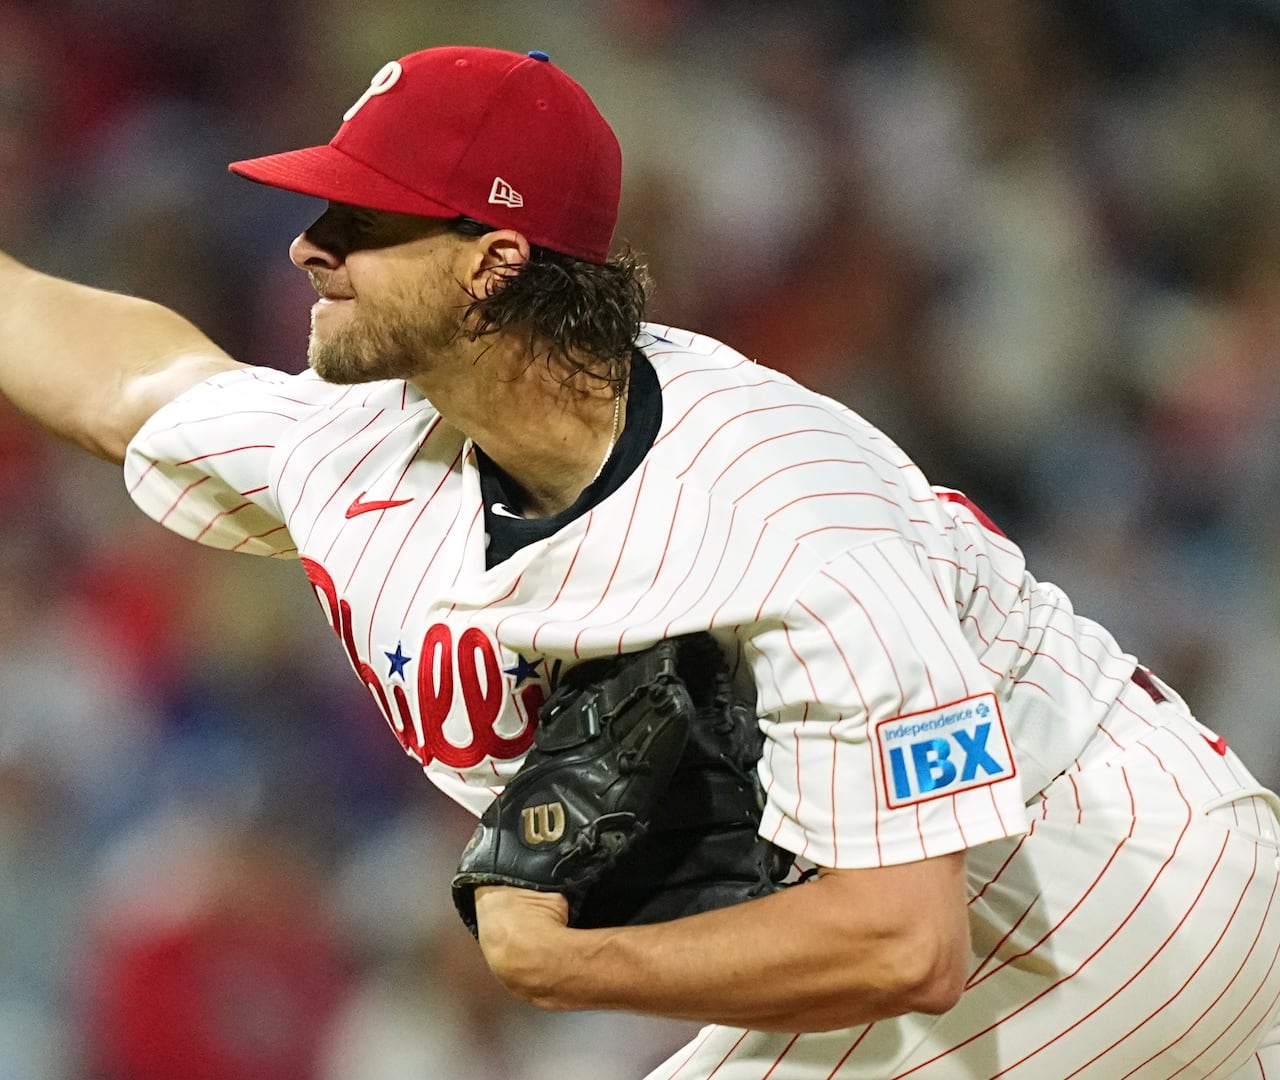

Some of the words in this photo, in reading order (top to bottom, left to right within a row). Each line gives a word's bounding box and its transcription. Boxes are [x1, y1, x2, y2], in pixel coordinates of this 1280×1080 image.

[343, 61, 403, 122] P
[885, 708, 973, 741] Independence
[889, 722, 1004, 799] IBX
